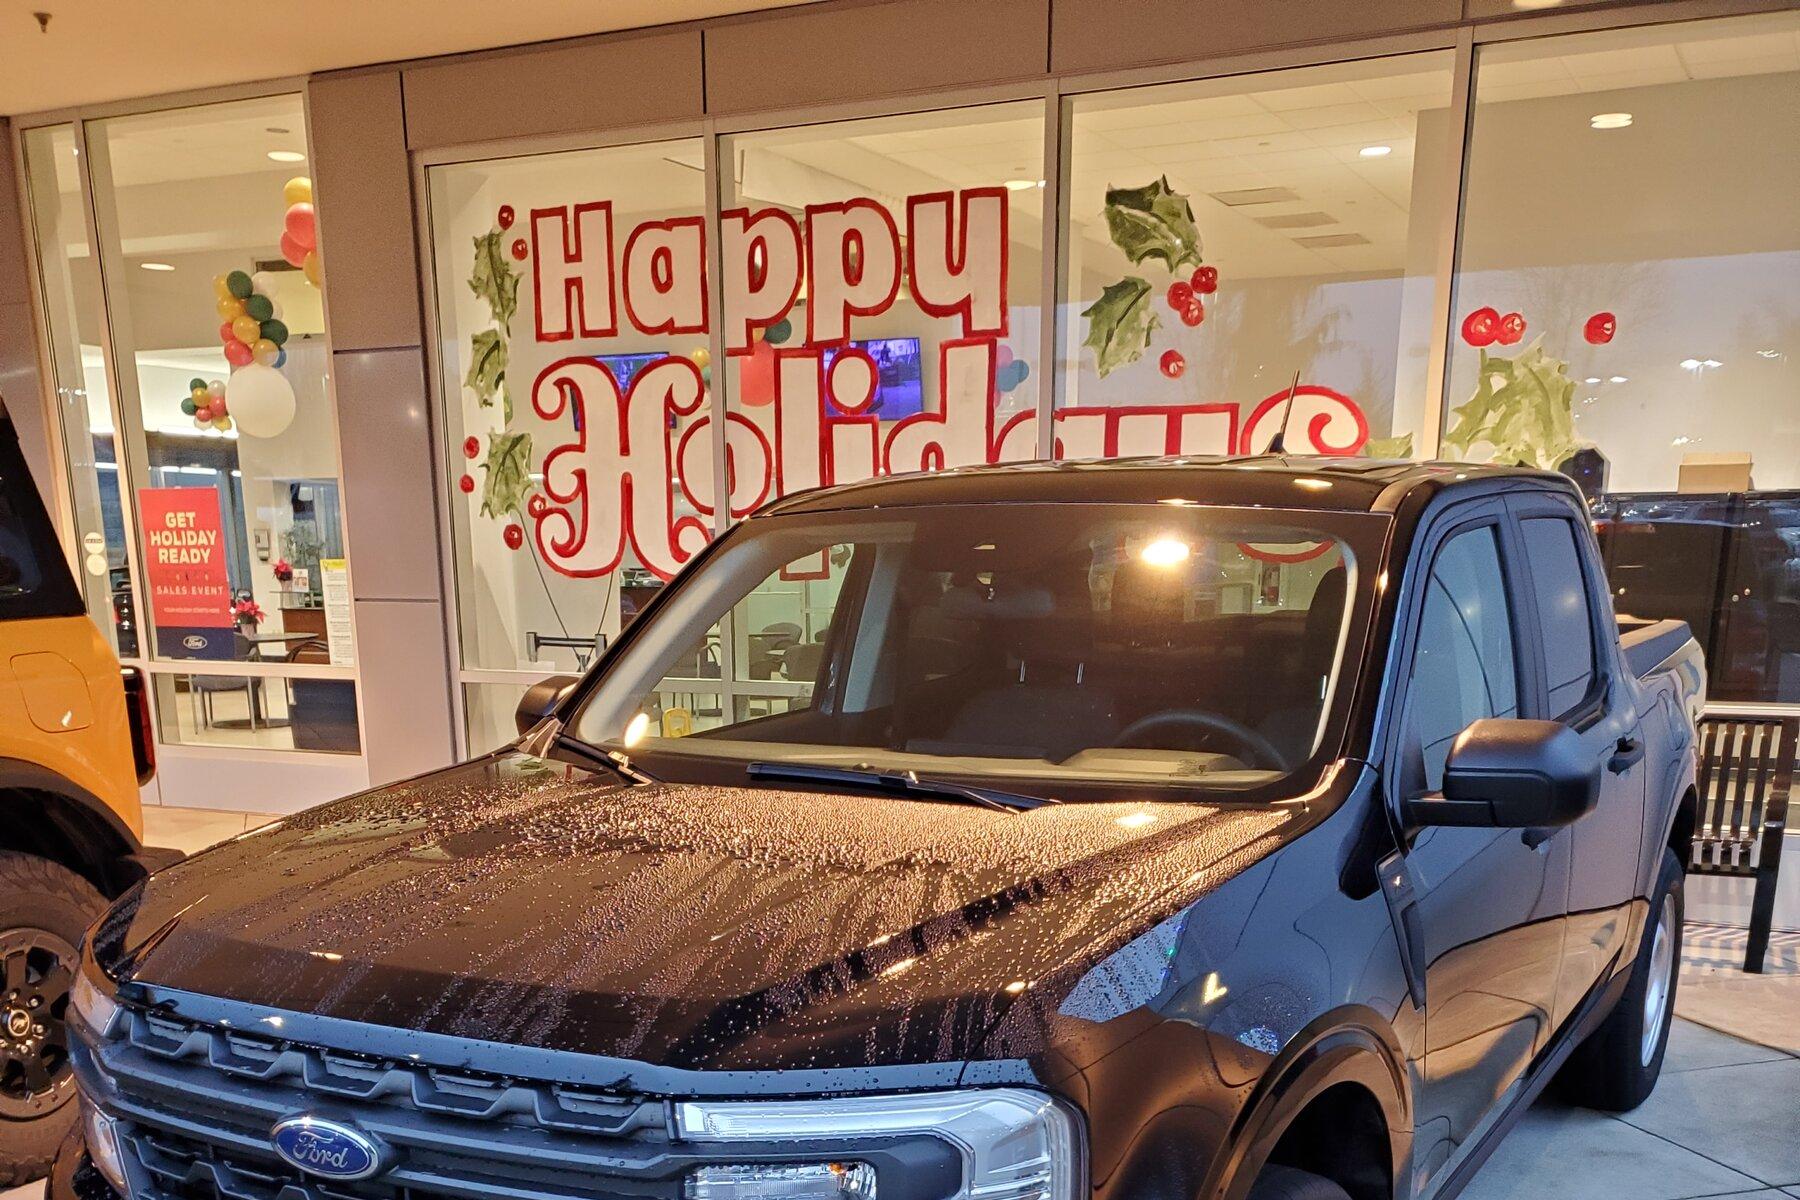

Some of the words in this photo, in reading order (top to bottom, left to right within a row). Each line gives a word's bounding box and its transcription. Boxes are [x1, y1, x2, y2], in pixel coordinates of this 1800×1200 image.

[530, 186, 1008, 356] Happy
[165, 511, 196, 528] GET
[149, 530, 217, 547] HOLIDAY
[158, 548, 211, 564] READY
[156, 585, 188, 596] SALES
[191, 585, 224, 596] EVENT
[292, 1130, 349, 1168] Ford
